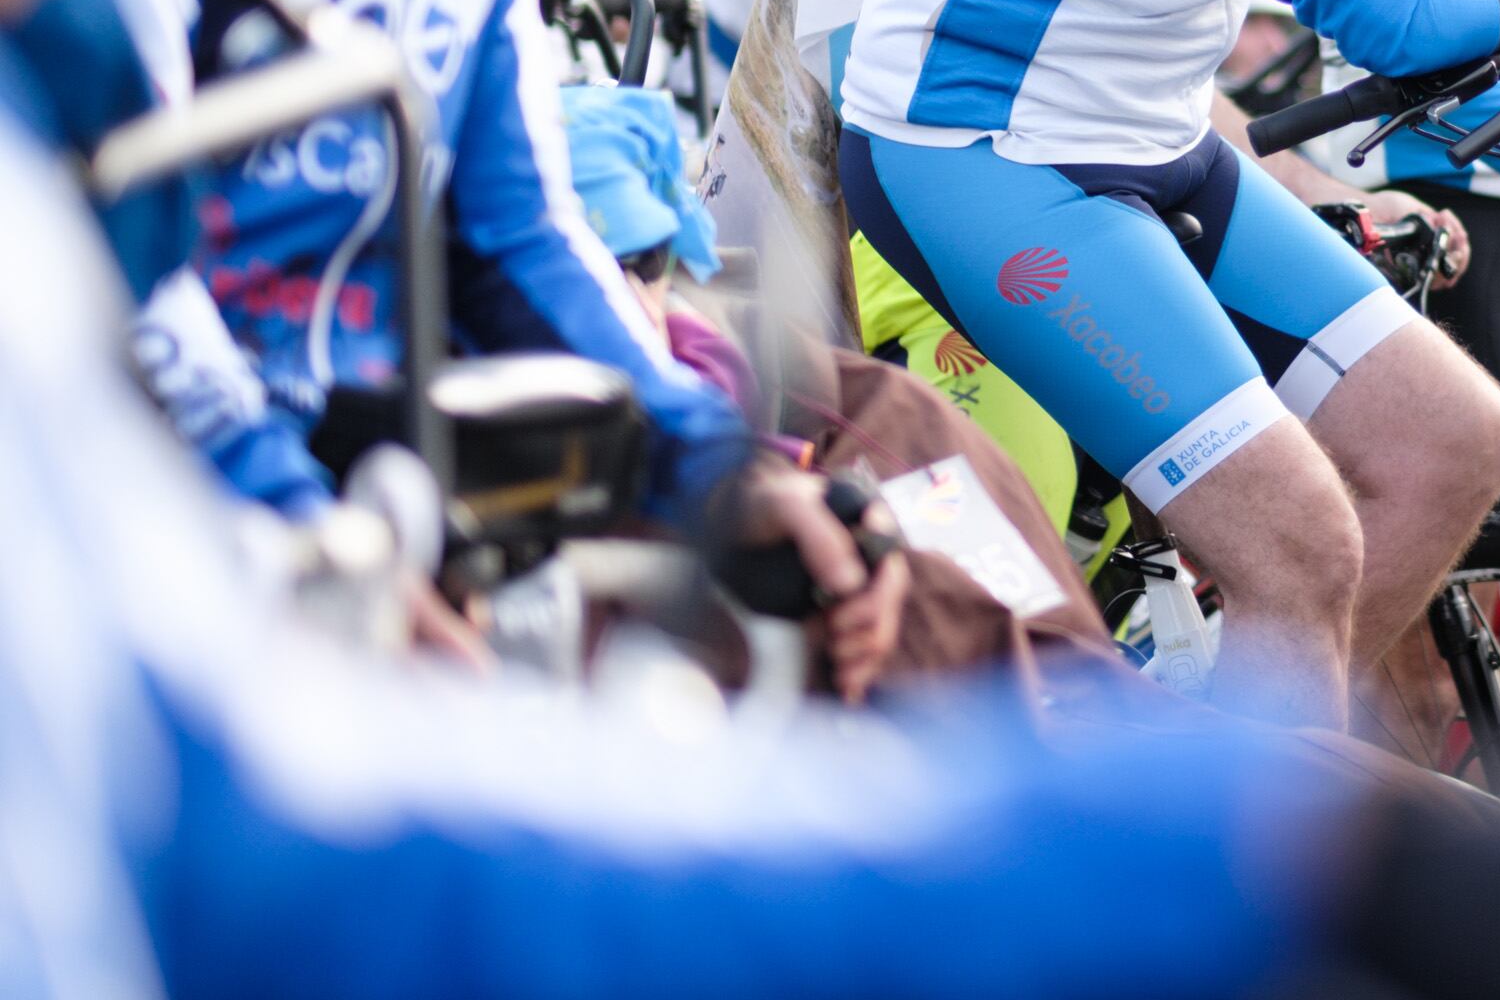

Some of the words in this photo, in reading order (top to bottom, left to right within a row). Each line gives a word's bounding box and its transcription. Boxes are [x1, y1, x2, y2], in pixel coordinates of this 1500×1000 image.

[1049, 294, 1171, 415] Xacobeo
[1177, 428, 1219, 463] XUNTA
[1184, 454, 1201, 473] DE
[1201, 419, 1251, 459] GALICIA
